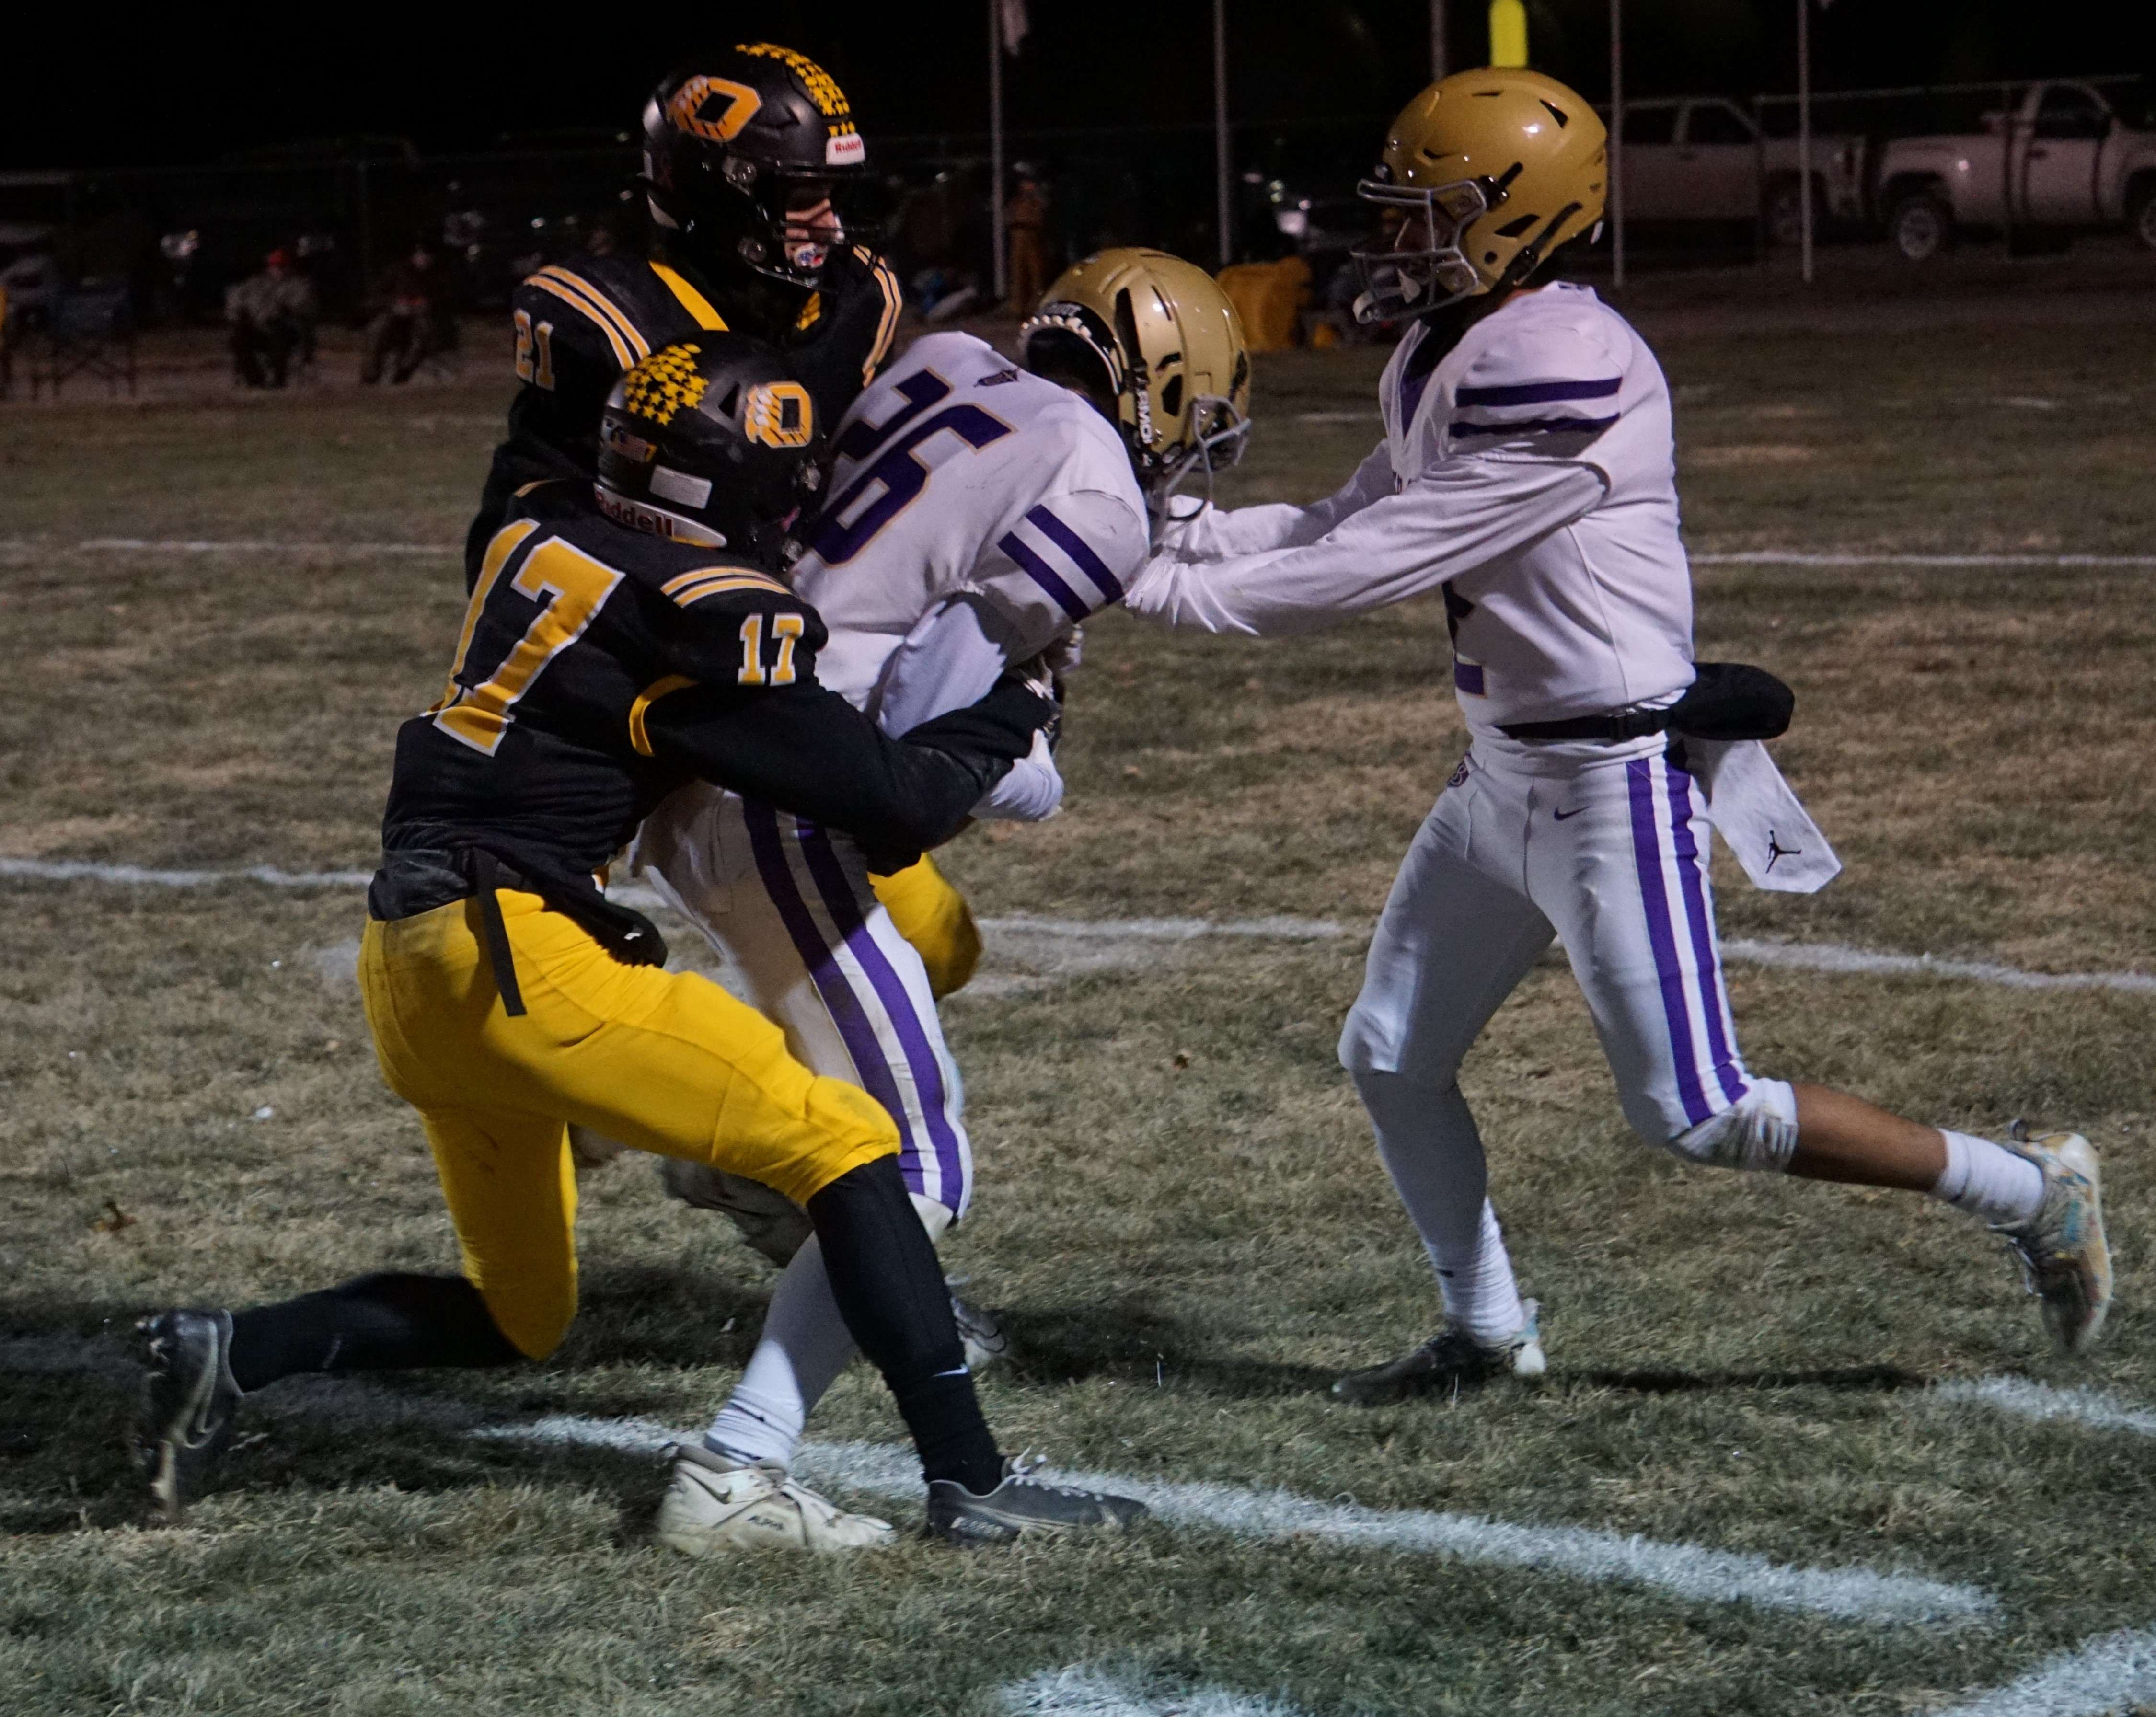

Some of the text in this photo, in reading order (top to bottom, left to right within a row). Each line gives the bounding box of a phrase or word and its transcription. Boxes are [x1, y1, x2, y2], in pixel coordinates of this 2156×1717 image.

[513, 307, 555, 392] 21
[420, 517, 626, 758] 17
[737, 612, 805, 686] 17
